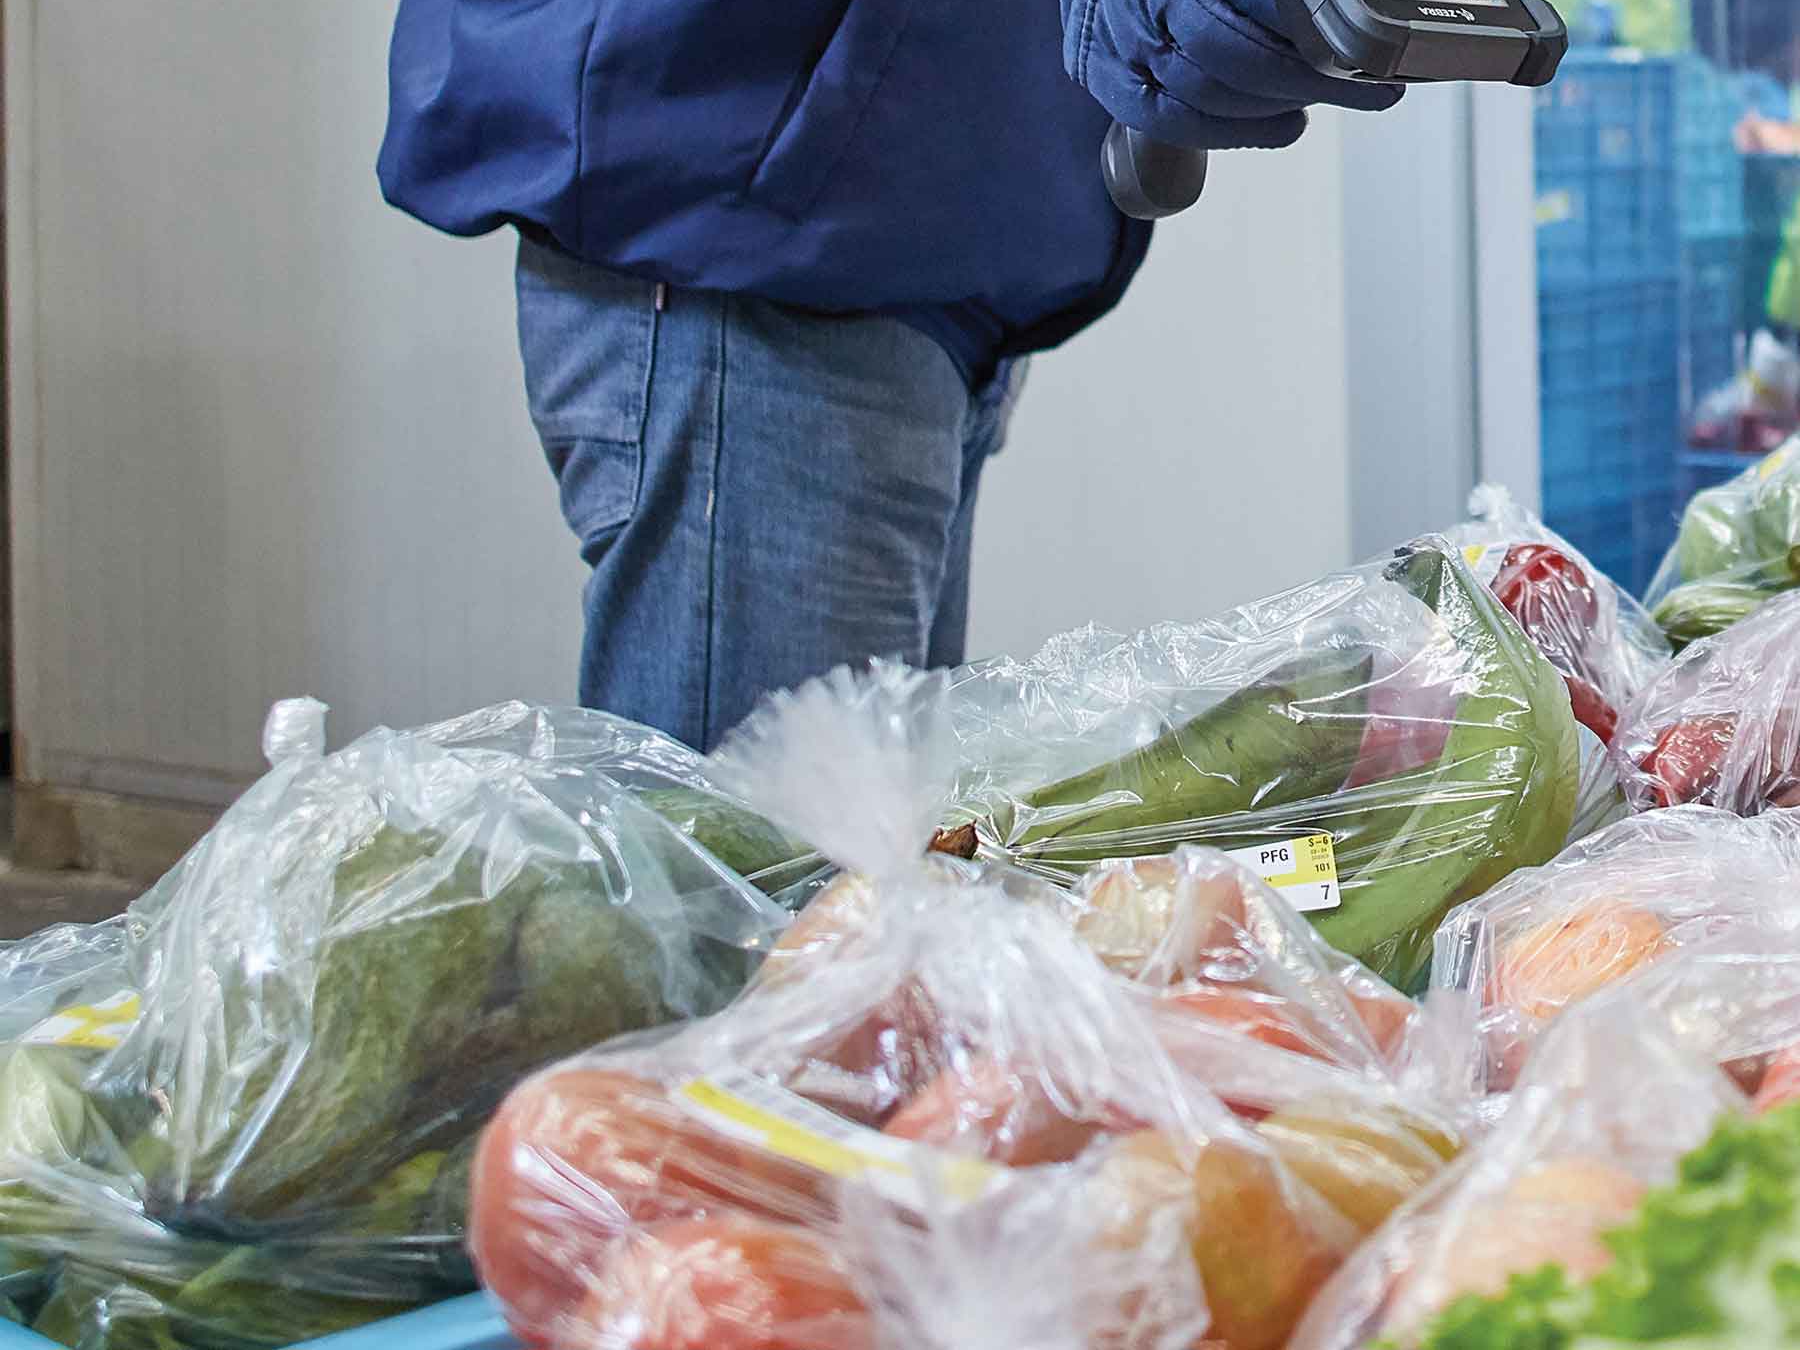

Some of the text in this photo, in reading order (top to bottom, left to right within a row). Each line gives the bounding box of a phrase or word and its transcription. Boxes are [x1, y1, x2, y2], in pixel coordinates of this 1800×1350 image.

[1417, 6, 1458, 18] ZEBRA
[1260, 848, 1289, 865] PFG
[1315, 862, 1330, 873] 101
[1320, 884, 1330, 900] 7
